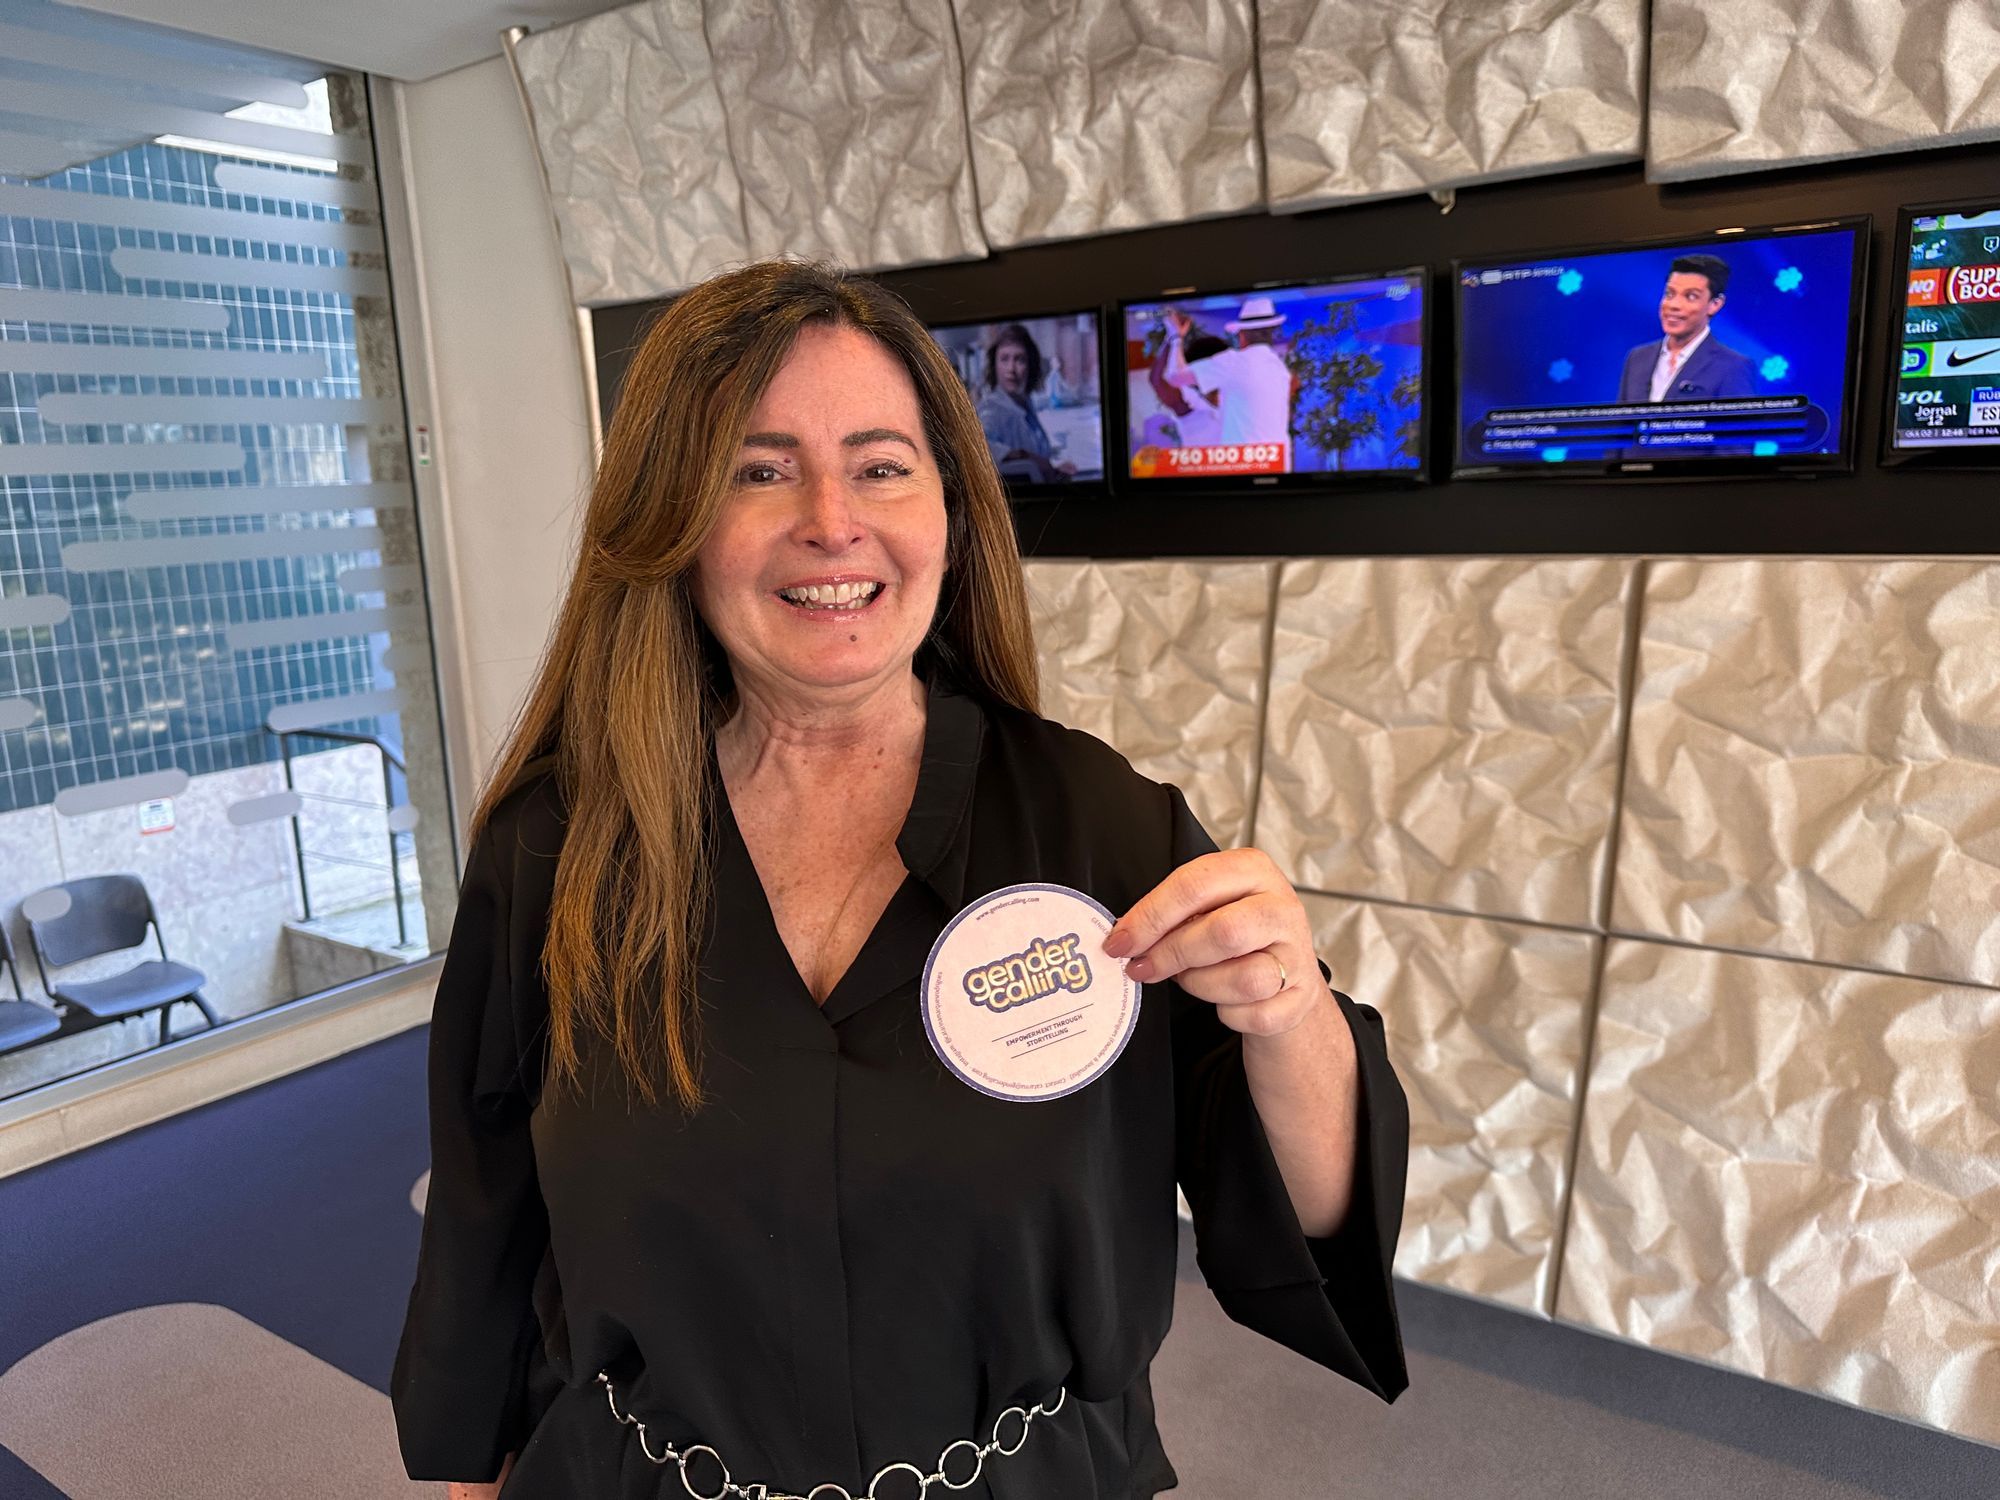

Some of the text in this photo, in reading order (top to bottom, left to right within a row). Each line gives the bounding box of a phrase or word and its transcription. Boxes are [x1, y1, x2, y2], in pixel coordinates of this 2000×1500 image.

[1915, 404, 1957, 418] Jornal
[1169, 445, 1279, 466] 760 100 802
[976, 897, 1040, 921] www.gendercalling.com
[968, 939, 1075, 1002] gender
[989, 957, 1088, 1008] calling
[1006, 1014, 1083, 1047] EMPOWERMENT THROUGH
[1026, 1027, 1069, 1047] STORYTELLING
